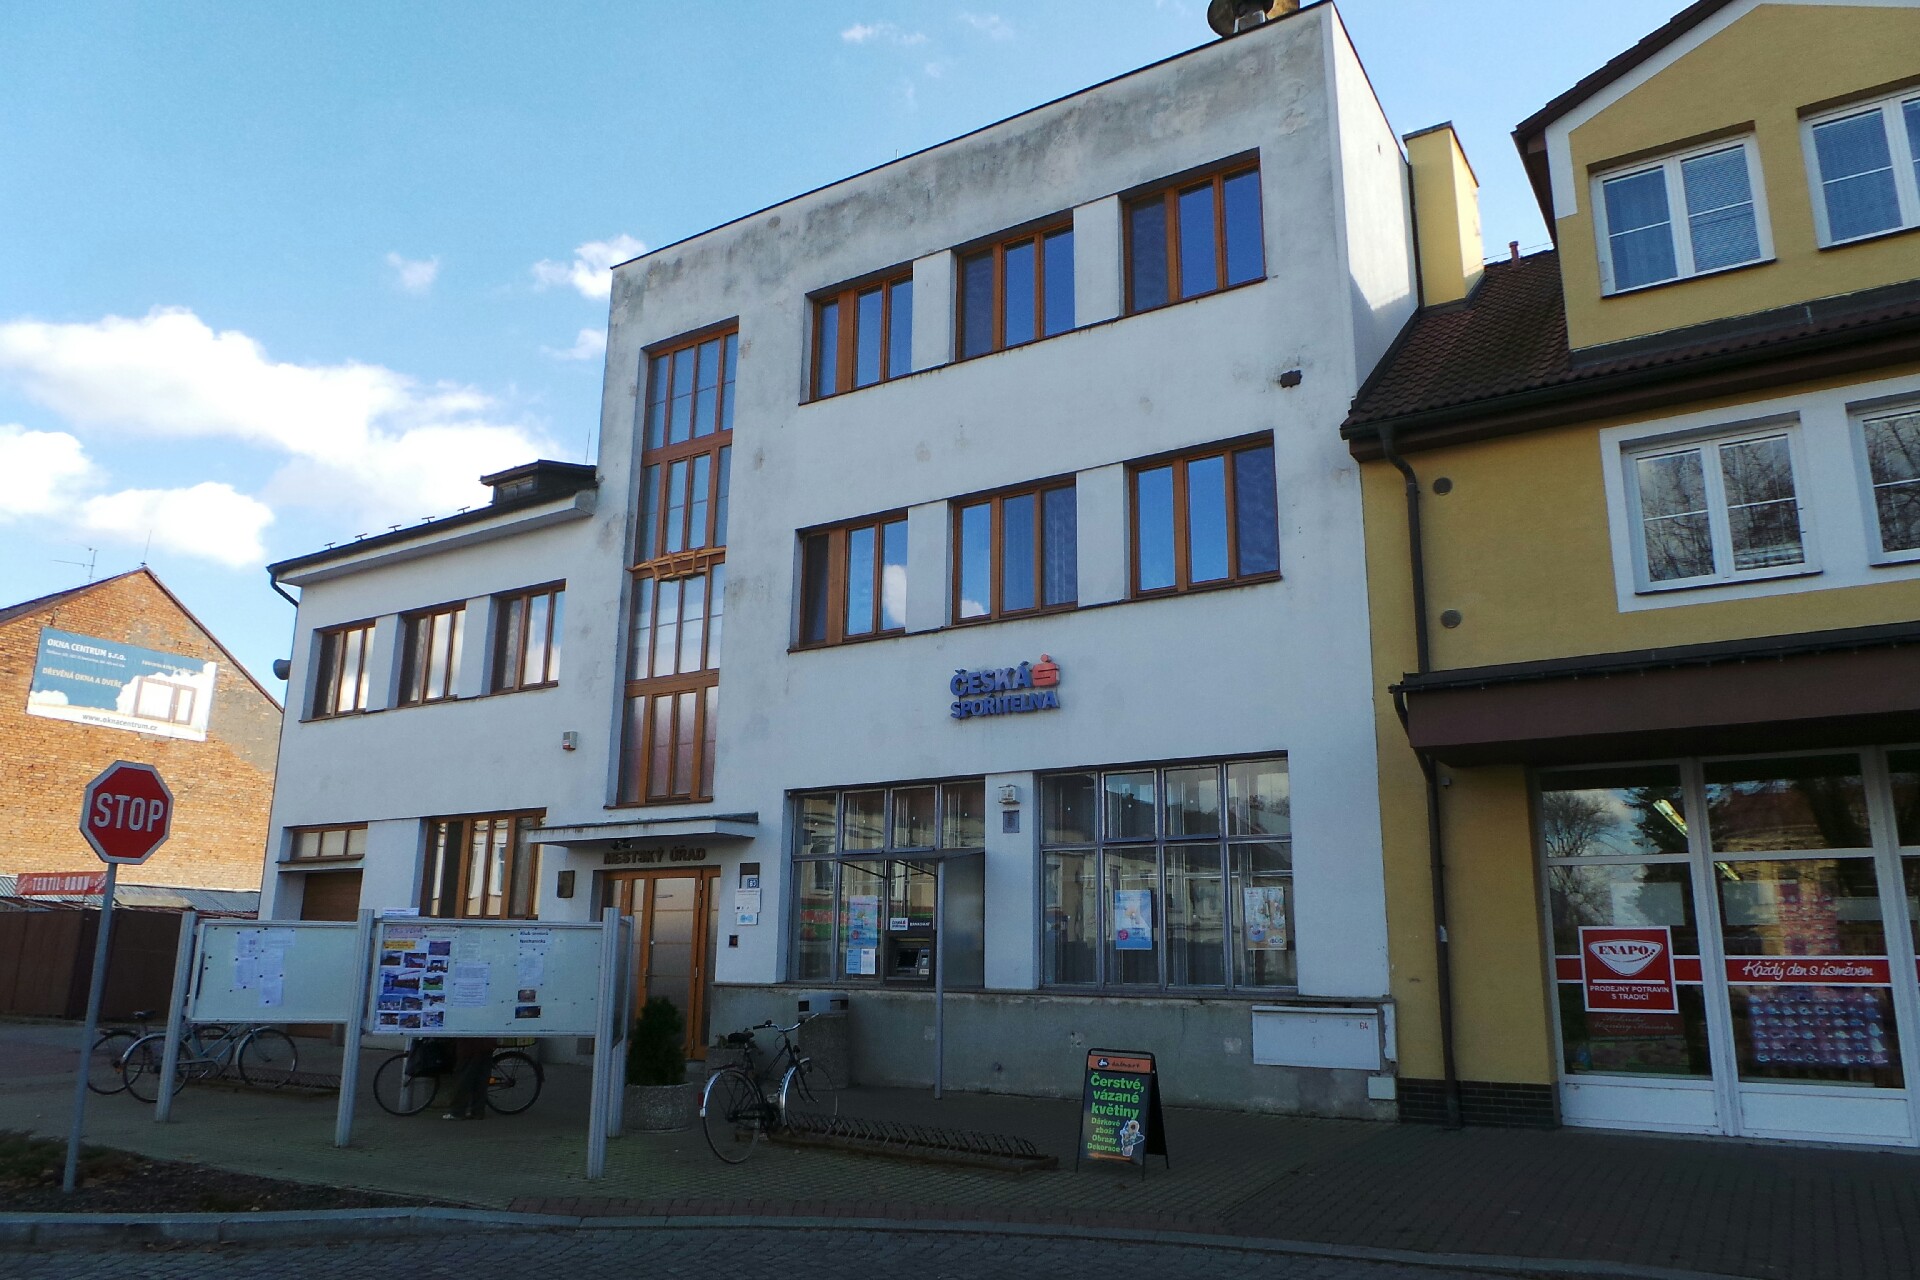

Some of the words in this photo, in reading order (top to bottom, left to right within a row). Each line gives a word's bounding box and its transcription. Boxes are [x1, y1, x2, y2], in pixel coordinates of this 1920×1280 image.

[47, 638, 70, 650] OKNA
[71, 643, 107, 657] CENTRUM
[107, 652, 127, 661] s.r.o.
[42, 667, 75, 679] DŘEVĚNÁ
[75, 673, 94, 683] OKNA
[102, 678, 122, 688] DVEŘE
[949, 660, 1032, 697] ČESKÁ
[950, 690, 1059, 719] SPOŘITELNA
[82, 713, 158, 731] www.oknacentrum.cz
[93, 792, 164, 833] STOP
[670, 845, 706, 862] ÚŘAD
[32, 876, 61, 891] TEXTIL
[64, 875, 91, 891] OBUV
[1598, 945, 1649, 955] ENAPO
[1742, 960, 1786, 980] Každý
[1786, 962, 1807, 976] den
[1809, 965, 1819, 976] s
[1820, 961, 1874, 977] úsměvem
[1618, 993, 1649, 1001] TRADICÍ
[1090, 1072, 1145, 1092] Čerstvé,
[1093, 1089, 1140, 1104] vázané
[1091, 1102, 1140, 1120] květiny
[1091, 1117, 1120, 1126] Dárkové
[1092, 1134, 1118, 1144] Obrazy
[1095, 1126, 1115, 1135] zboží
[1087, 1142, 1120, 1153] Dekorace
